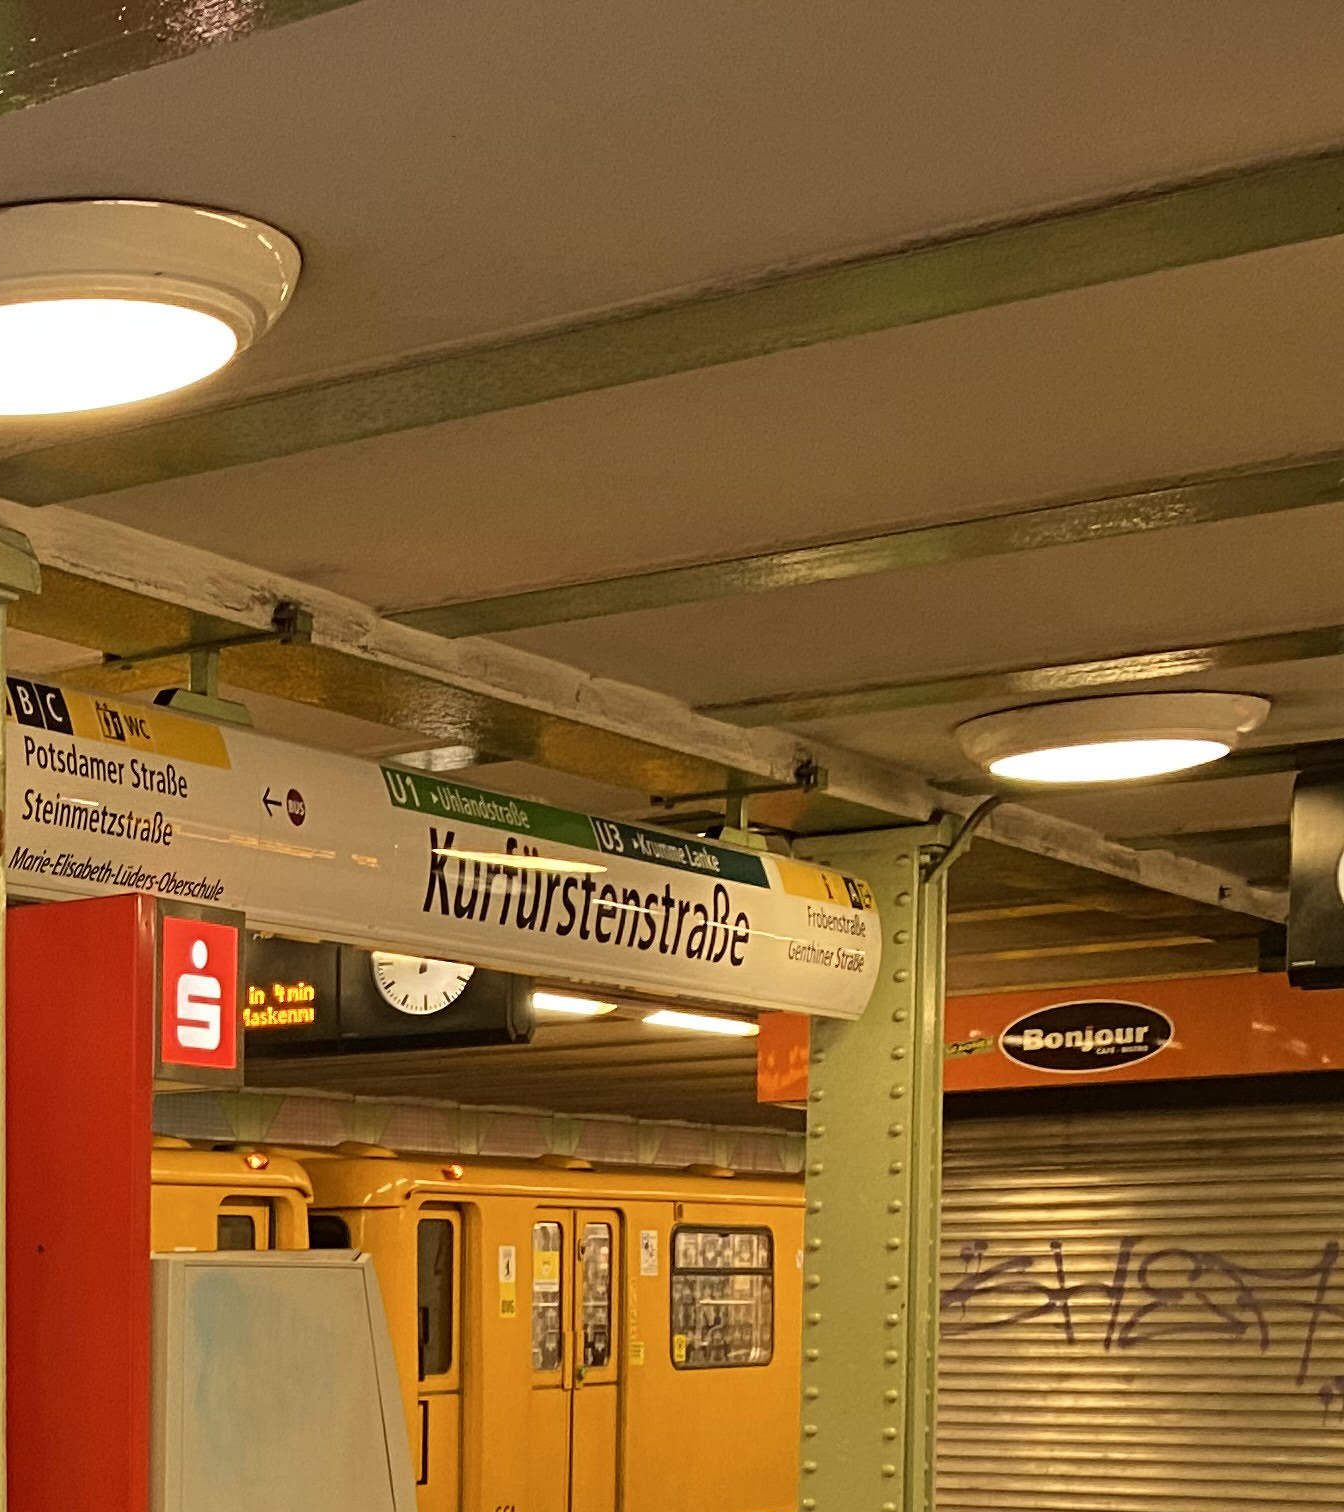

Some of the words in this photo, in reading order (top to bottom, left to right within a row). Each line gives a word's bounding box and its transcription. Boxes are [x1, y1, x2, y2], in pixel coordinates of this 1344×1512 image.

[16, 686, 34, 715] B
[46, 693, 64, 722] C
[123, 714, 151, 740] WC
[23, 735, 126, 785] Potsdamer
[131, 758, 189, 799] Straße
[21, 789, 174, 846] Steinmetzstraße
[386, 771, 420, 807] U1
[437, 786, 530, 829] Uhlandstraße
[595, 821, 624, 853] U3
[636, 833, 687, 865] Krumme
[684, 844, 721, 872] Lanke
[8, 846, 225, 901] Marie-Elisabeth-Lüders-Oberschule
[423, 827, 752, 968] Kurfürstenstraße
[807, 905, 866, 938] Frobenstraße
[788, 941, 834, 968] Genthiner
[248, 985, 266, 1005] in
[287, 981, 315, 1003] min
[1023, 1026, 1150, 1052] Bonjour
